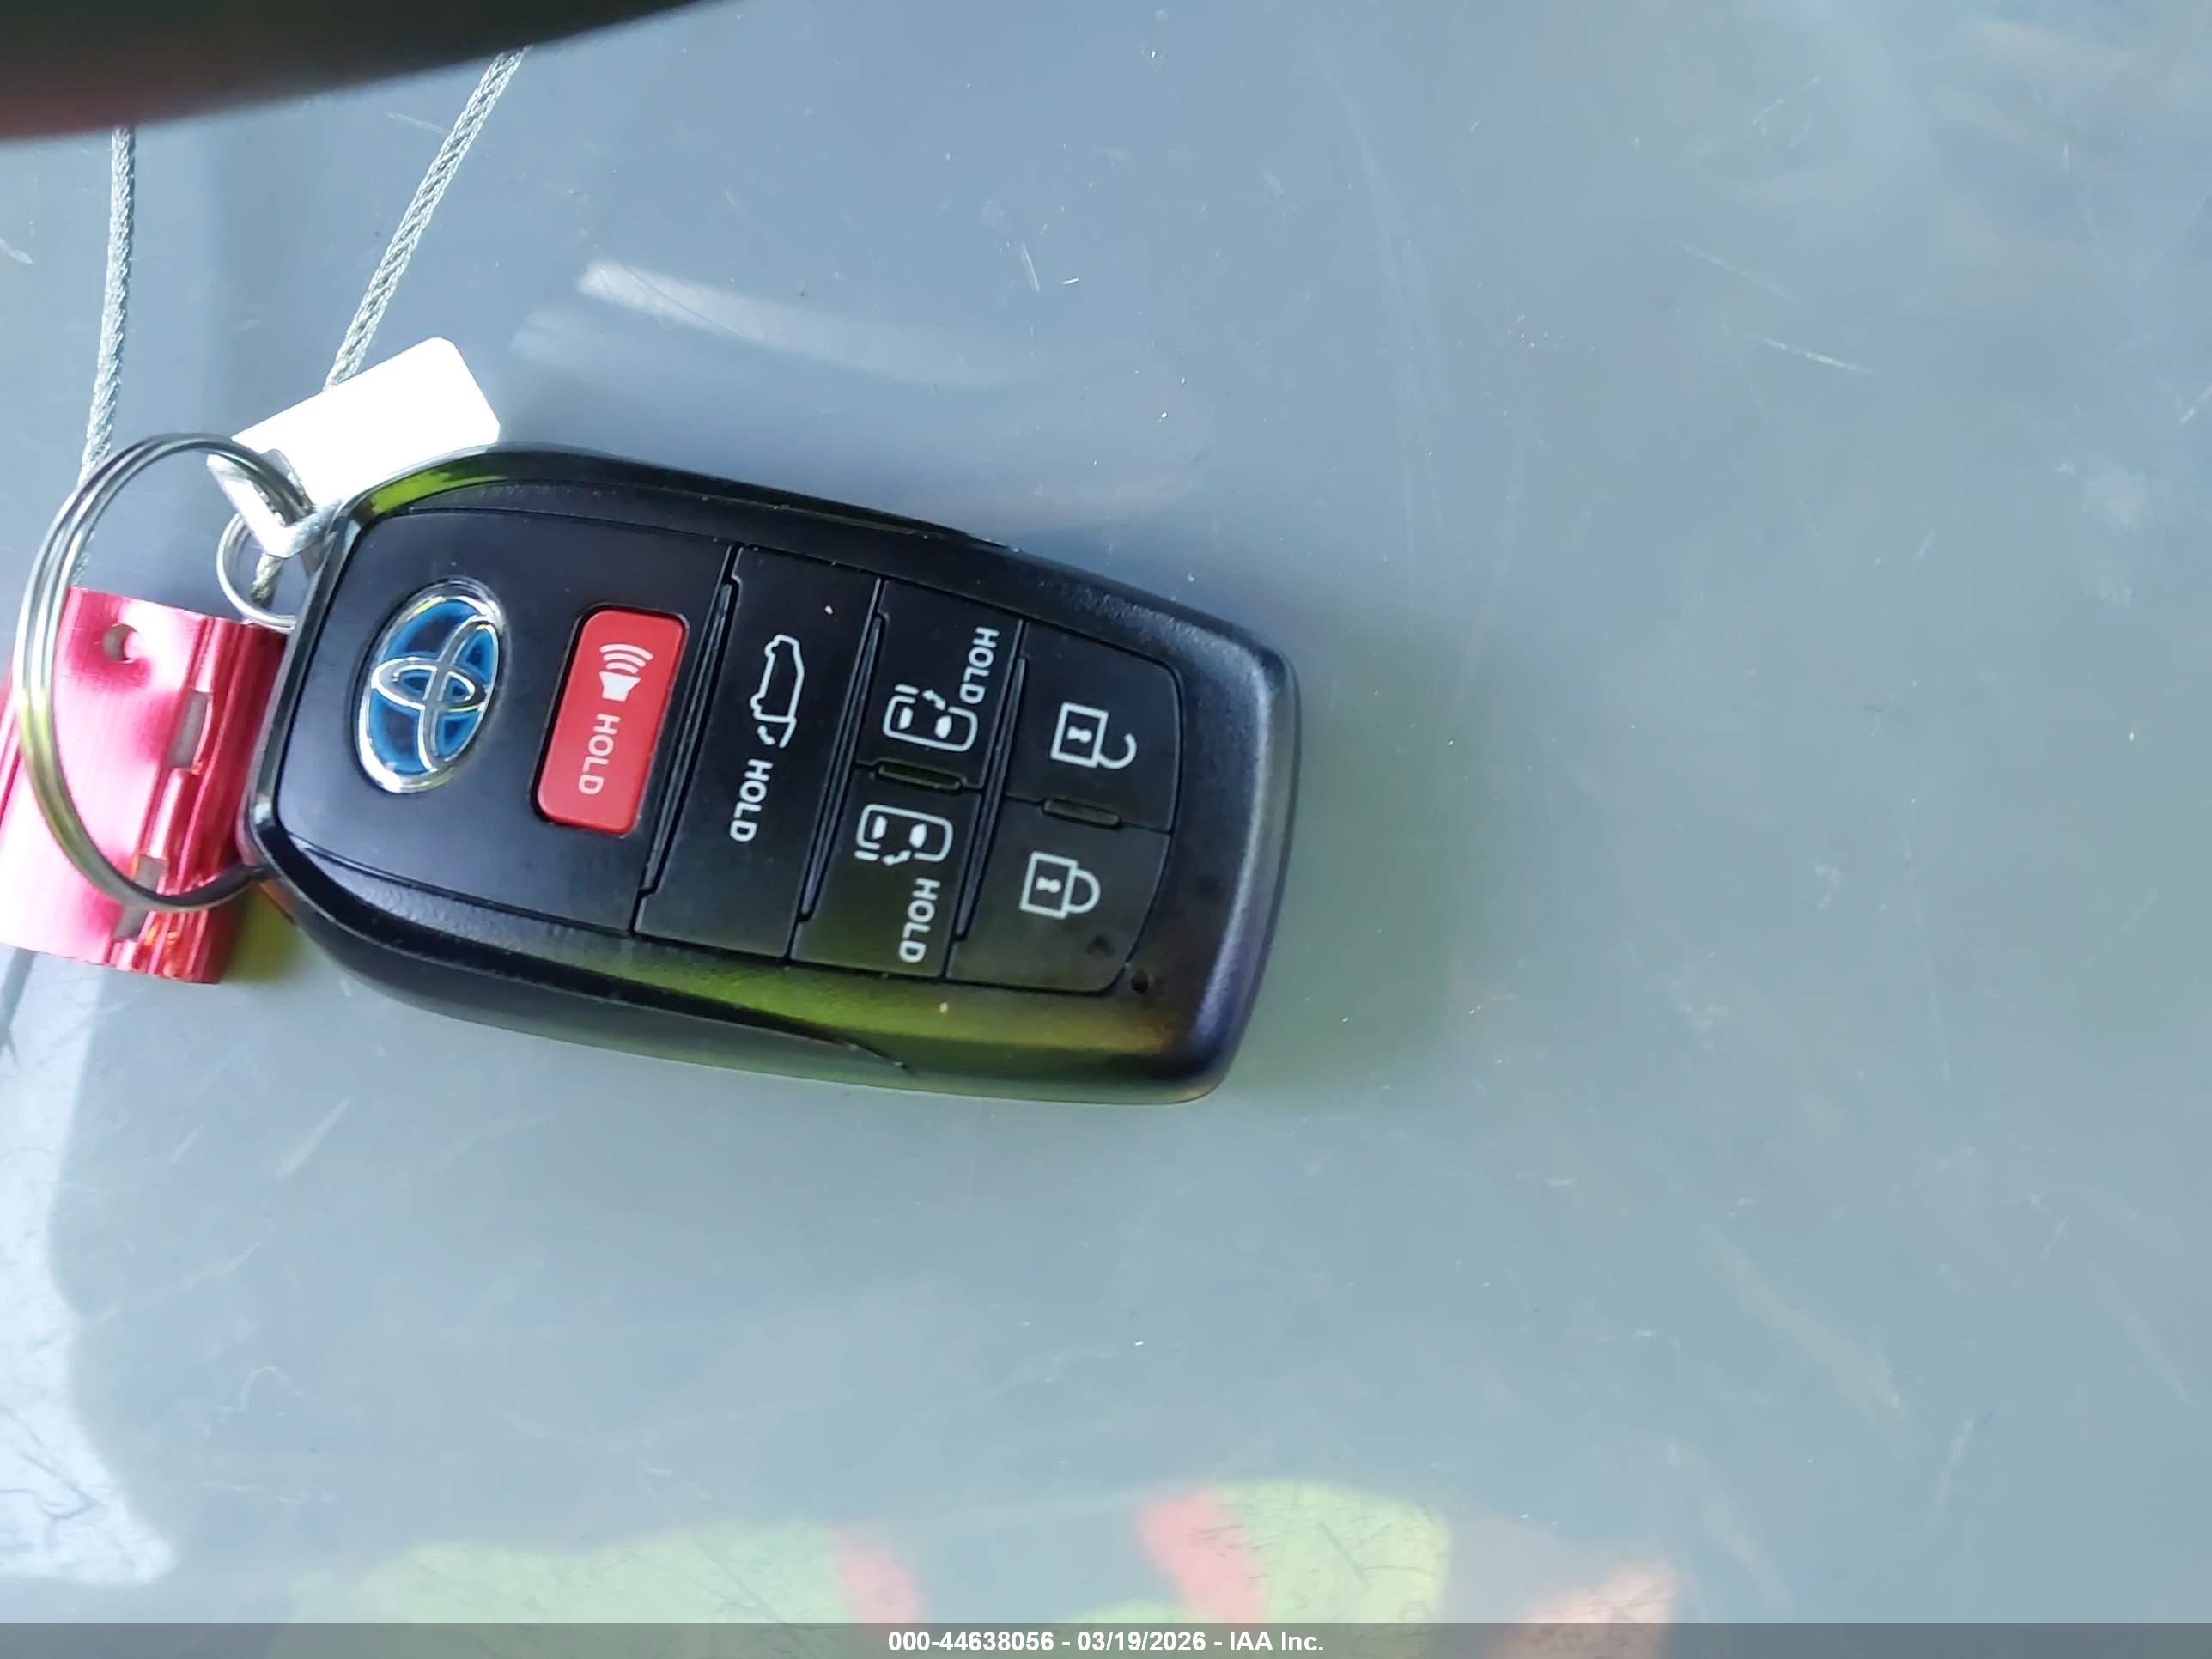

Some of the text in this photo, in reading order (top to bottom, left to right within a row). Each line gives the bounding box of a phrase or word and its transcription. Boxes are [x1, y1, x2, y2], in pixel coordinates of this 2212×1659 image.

[959, 626, 1000, 705] HOLD
[578, 714, 621, 795] HOLD
[729, 758, 774, 842] HOLD
[898, 878, 941, 963] HOLD
